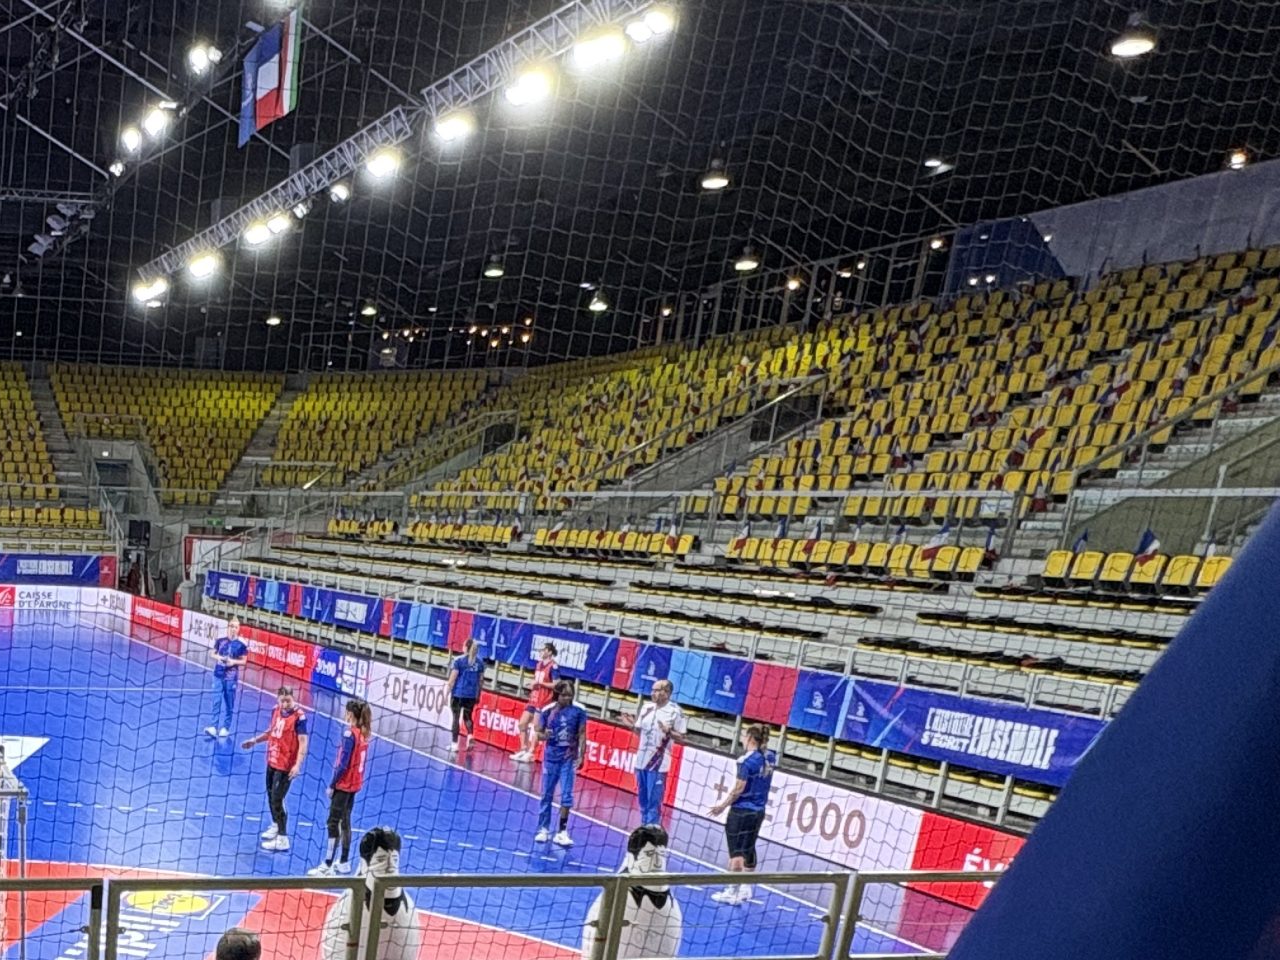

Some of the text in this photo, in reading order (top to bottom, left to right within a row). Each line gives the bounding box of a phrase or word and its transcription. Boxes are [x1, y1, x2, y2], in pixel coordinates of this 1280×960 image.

[18, 591, 53, 600] CAISSE
[393, 677, 410, 704] DE
[967, 716, 1059, 770] ENSEMBLE
[786, 792, 867, 849] 1000
